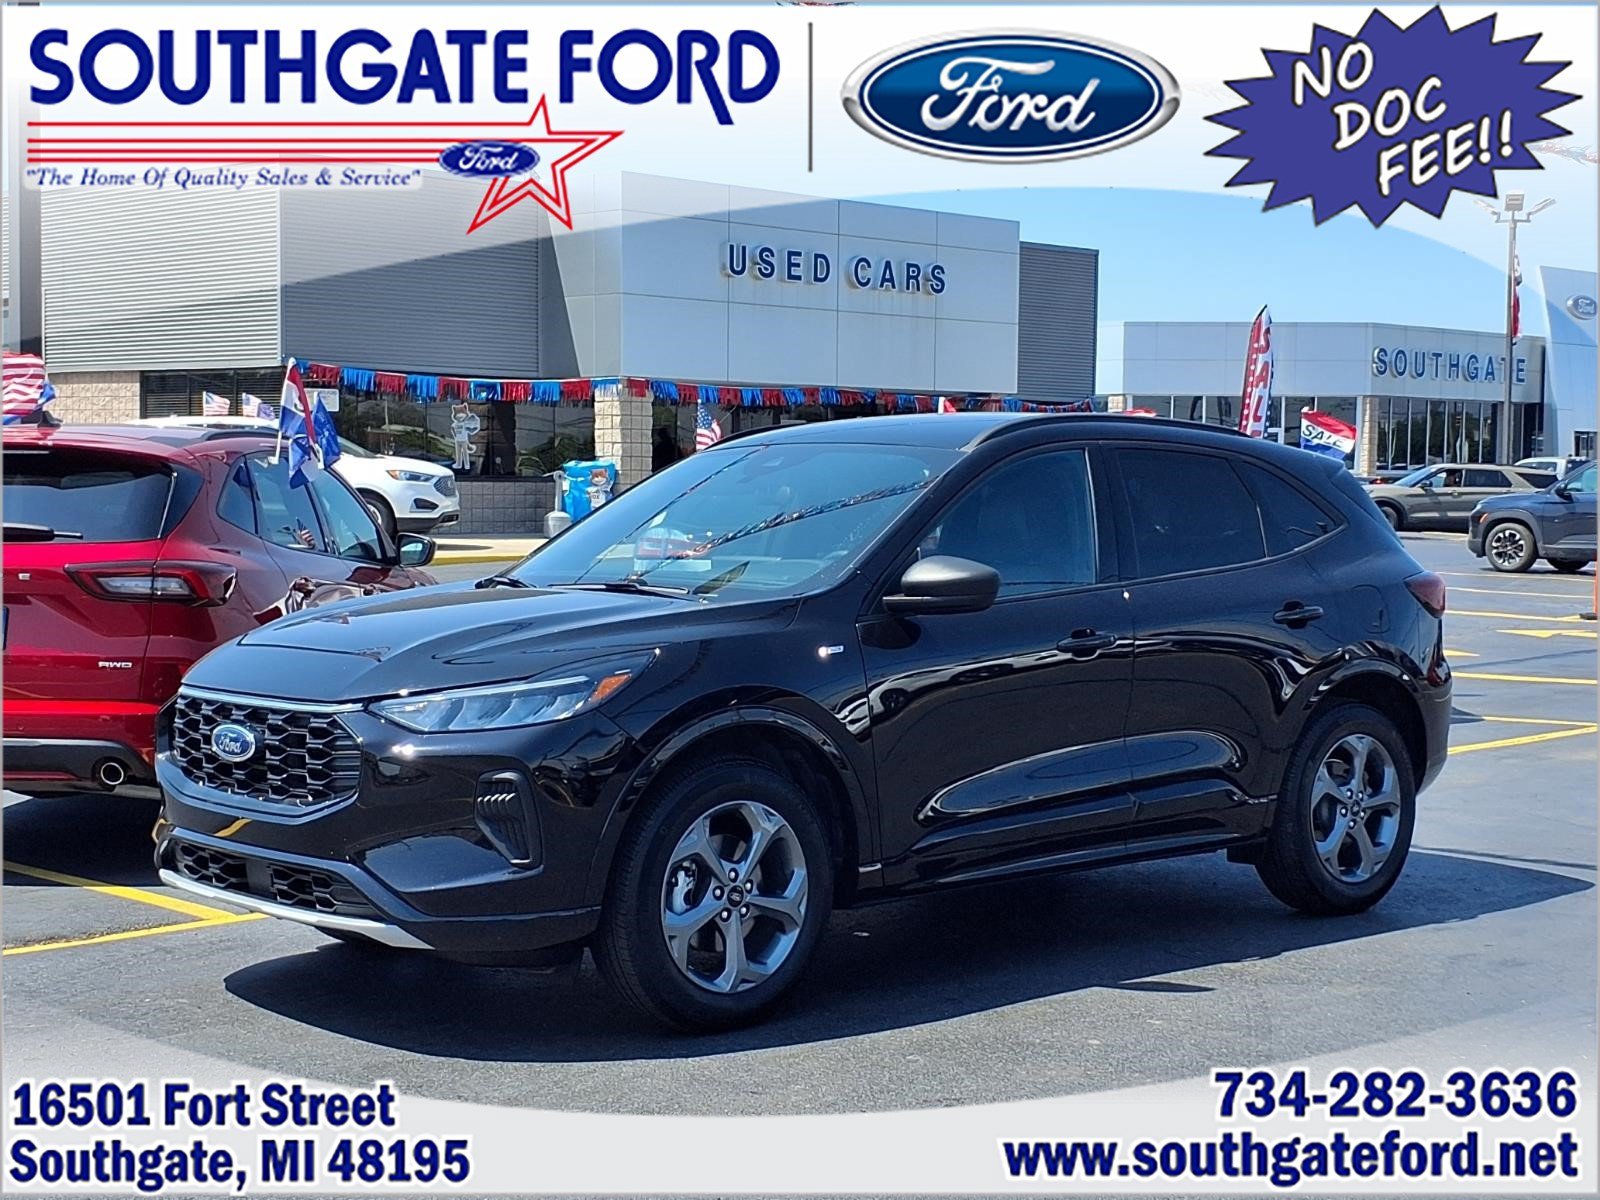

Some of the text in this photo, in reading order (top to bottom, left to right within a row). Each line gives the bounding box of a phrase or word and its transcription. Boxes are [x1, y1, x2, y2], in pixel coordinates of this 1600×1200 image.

[725, 243, 947, 296] USED CARS
[97, 661, 133, 669] AWD
[218, 730, 244, 754] Ford
